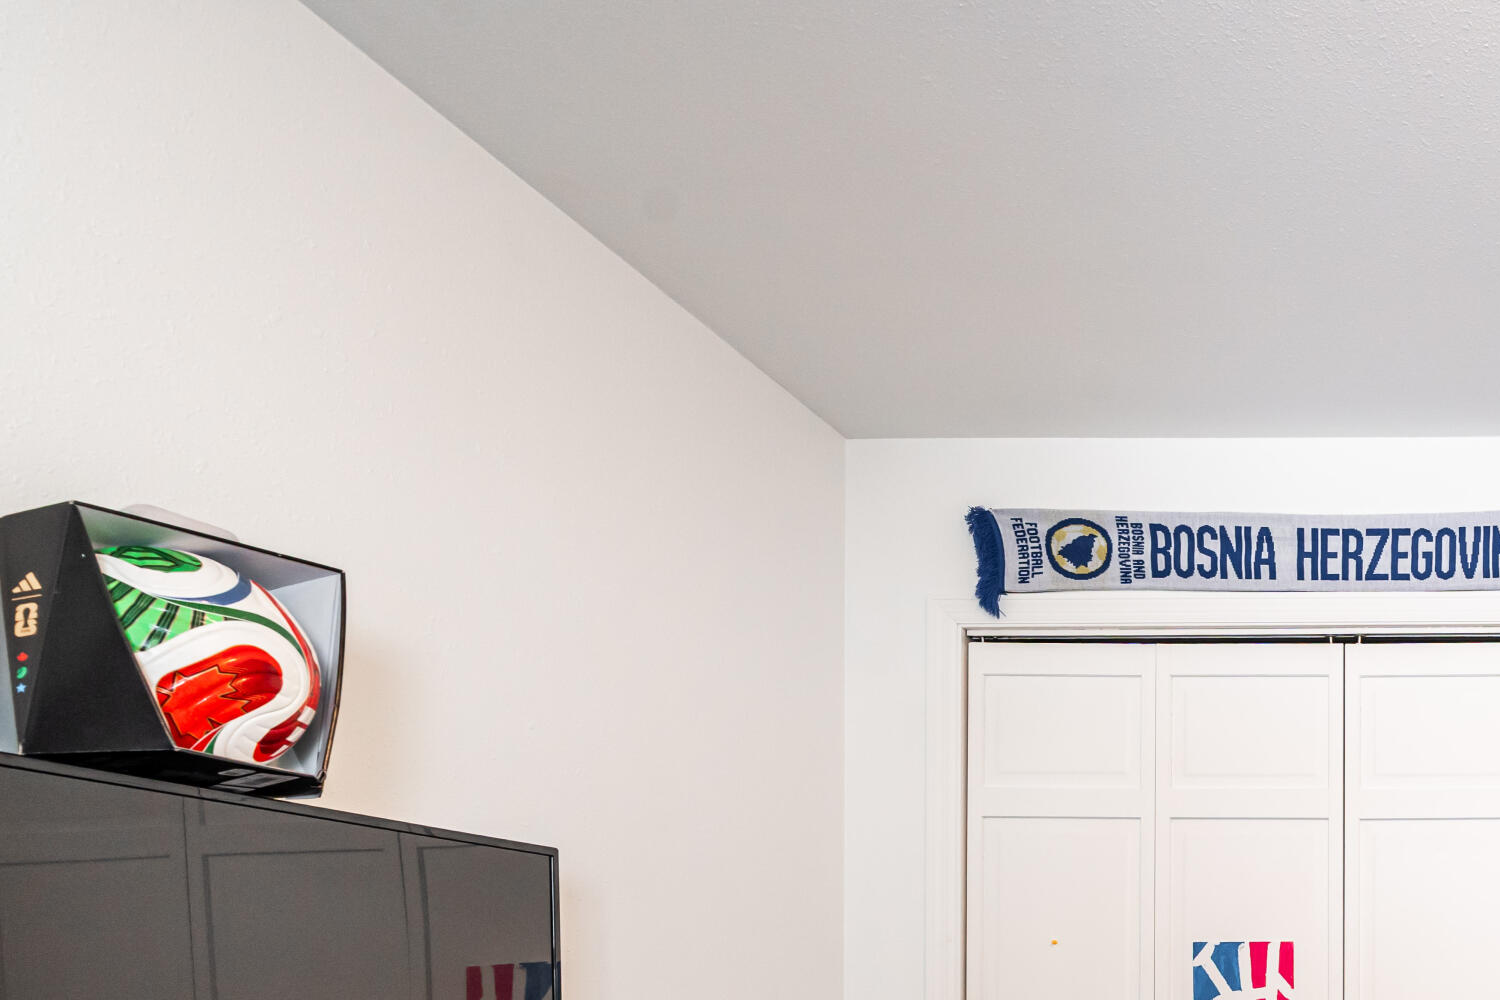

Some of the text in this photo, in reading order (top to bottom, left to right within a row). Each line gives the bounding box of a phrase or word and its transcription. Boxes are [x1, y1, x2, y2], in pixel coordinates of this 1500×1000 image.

[1010, 517, 1030, 584] FEDERATION
[1025, 522, 1043, 578] FOOTBALL
[1115, 515, 1132, 585] HERZEGOVINA
[1130, 522, 1146, 580] BOSNIA AND
[1149, 523, 1277, 579] BOSNIA
